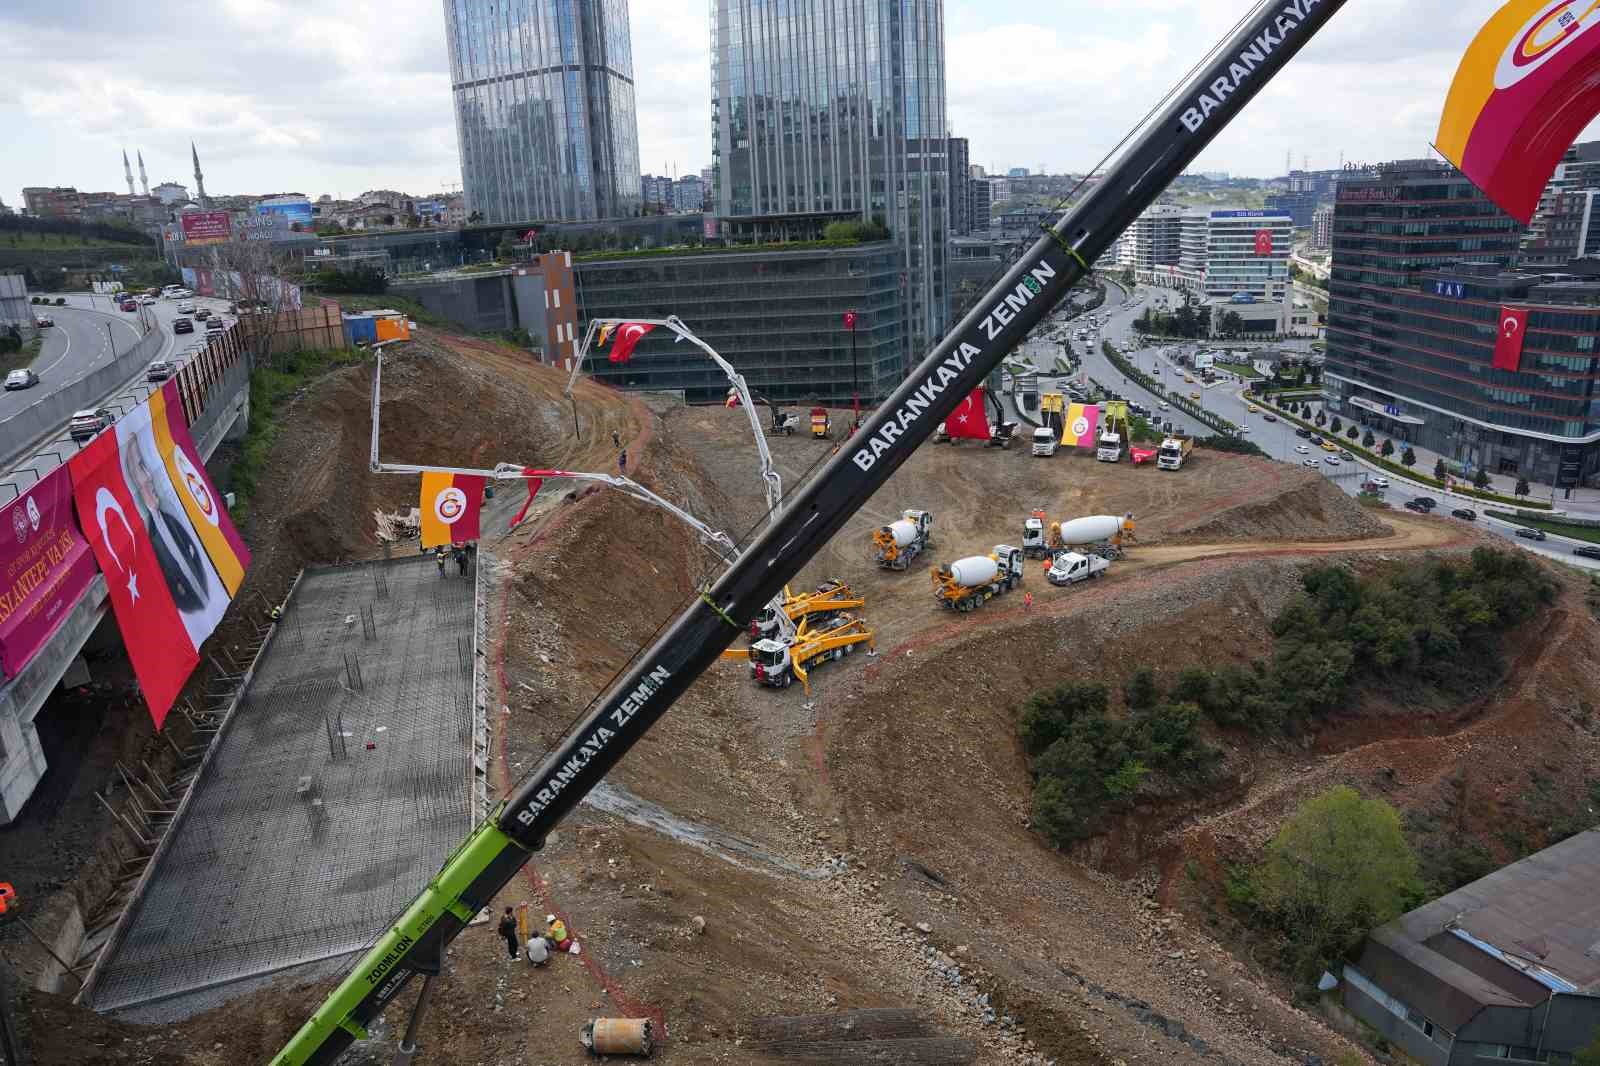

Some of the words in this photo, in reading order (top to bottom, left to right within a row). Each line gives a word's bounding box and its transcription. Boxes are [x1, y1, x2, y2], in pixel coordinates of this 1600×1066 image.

[1179, 0, 1321, 133] BARANKAYA
[1436, 282, 1463, 297] TAV
[852, 342, 982, 472] BARANKAYA
[0, 553, 50, 624] SLANTEPE
[517, 726, 616, 826] BARANKAYA
[366, 935, 414, 985] ZOOMLION
